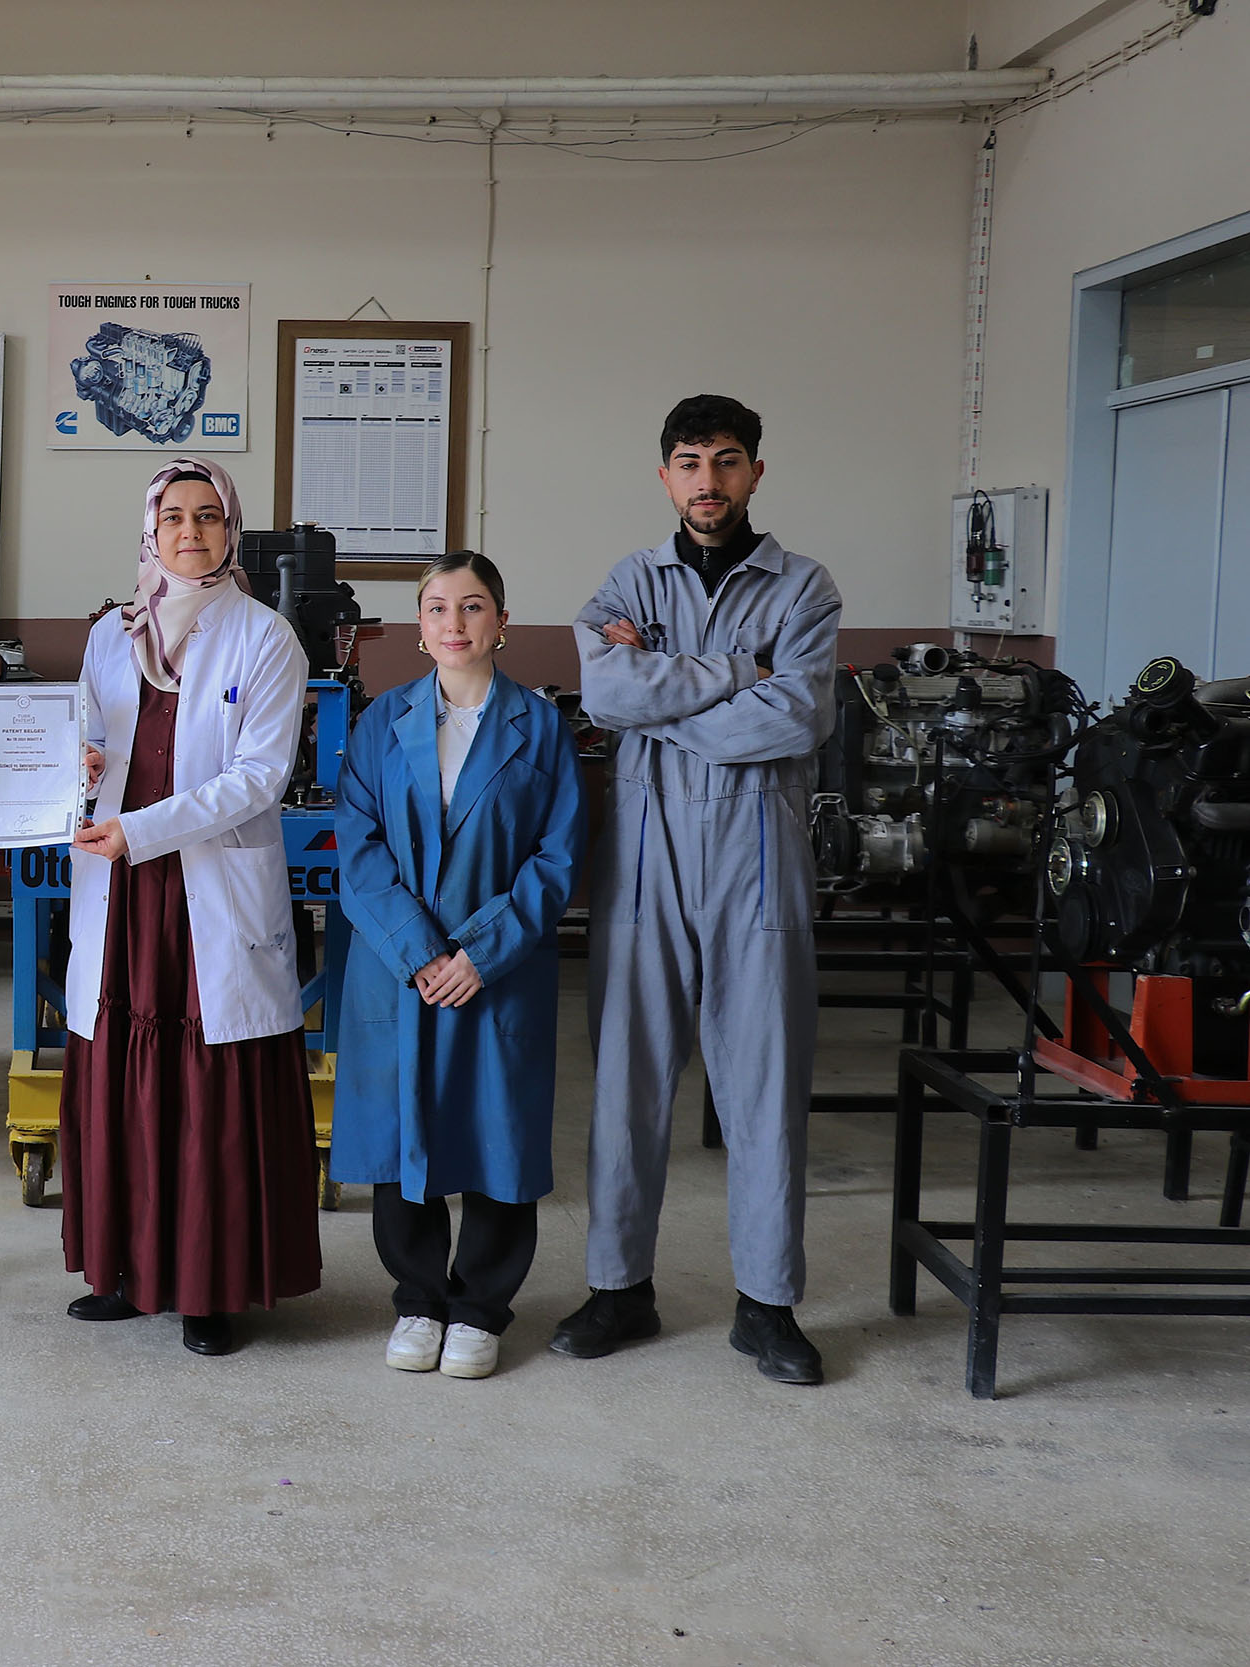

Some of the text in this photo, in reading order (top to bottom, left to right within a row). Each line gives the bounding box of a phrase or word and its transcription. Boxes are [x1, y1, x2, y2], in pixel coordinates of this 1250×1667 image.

[58, 295, 240, 309] TOUGH ENGINES FOR TOUGH TRUCKS
[205, 417, 237, 433] BMC
